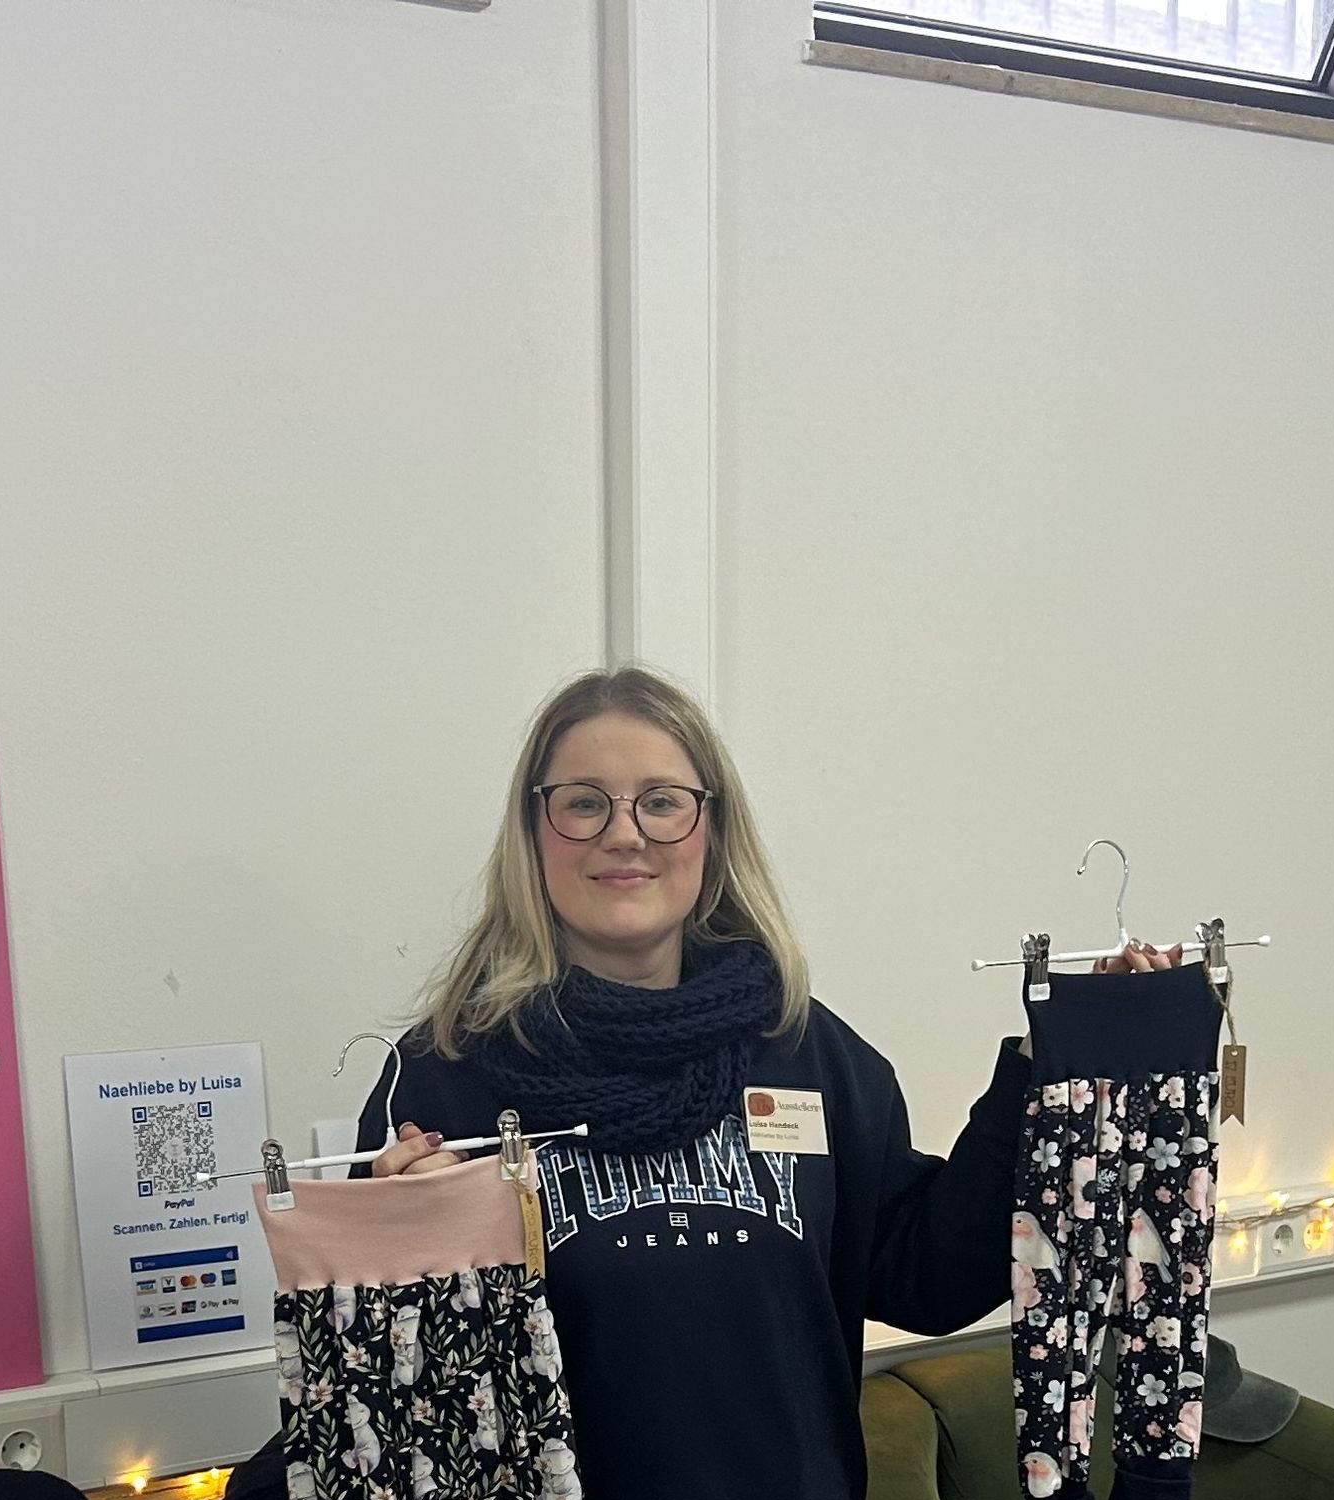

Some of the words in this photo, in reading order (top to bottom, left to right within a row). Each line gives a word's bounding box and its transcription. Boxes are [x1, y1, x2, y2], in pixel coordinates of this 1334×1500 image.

[99, 1078, 175, 1099] Naehliebe
[178, 1077, 197, 1095] by
[201, 1074, 243, 1091] Luisa
[164, 1198, 195, 1210] PayPal
[113, 1221, 167, 1236] Scannen.
[169, 1216, 211, 1231] Zahlen.
[213, 1210, 250, 1226] Fertig!
[616, 1229, 750, 1250] JEANS
